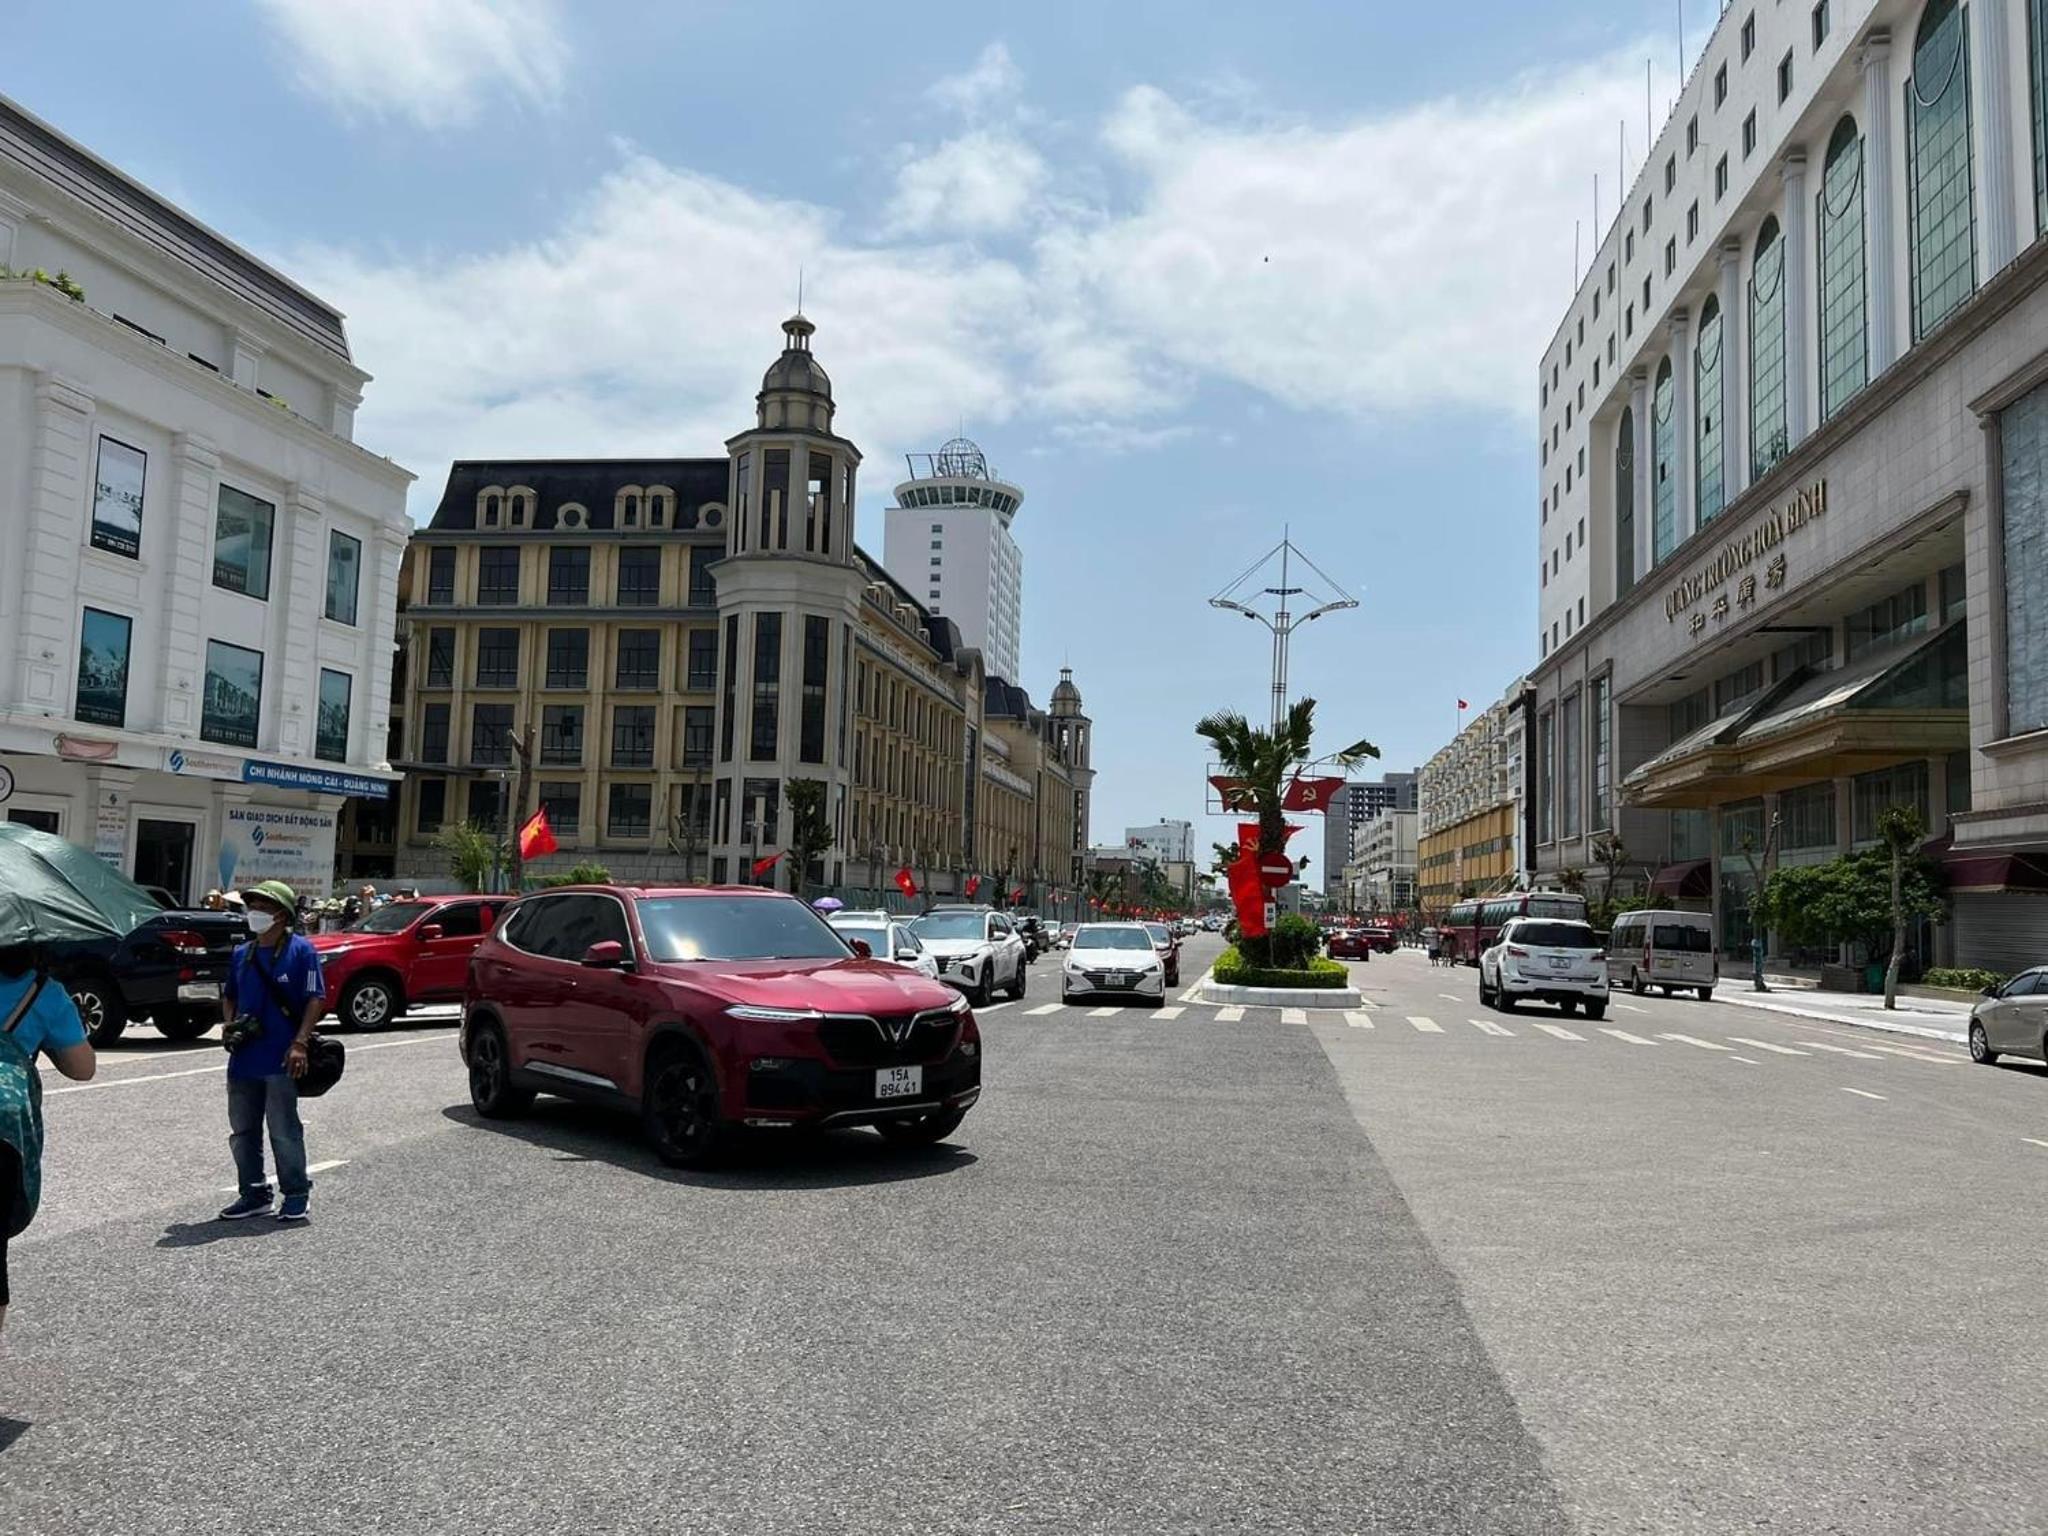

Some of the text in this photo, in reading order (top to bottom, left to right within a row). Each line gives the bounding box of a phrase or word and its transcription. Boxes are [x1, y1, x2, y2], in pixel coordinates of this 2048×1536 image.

[1785, 478, 1827, 537] BÌNH
[250, 766, 266, 777] CHI
[267, 767, 297, 782] NHÁNH
[246, 811, 264, 822] GIAO
[266, 813, 283, 824] DỊCH
[891, 1069, 909, 1081] 15A
